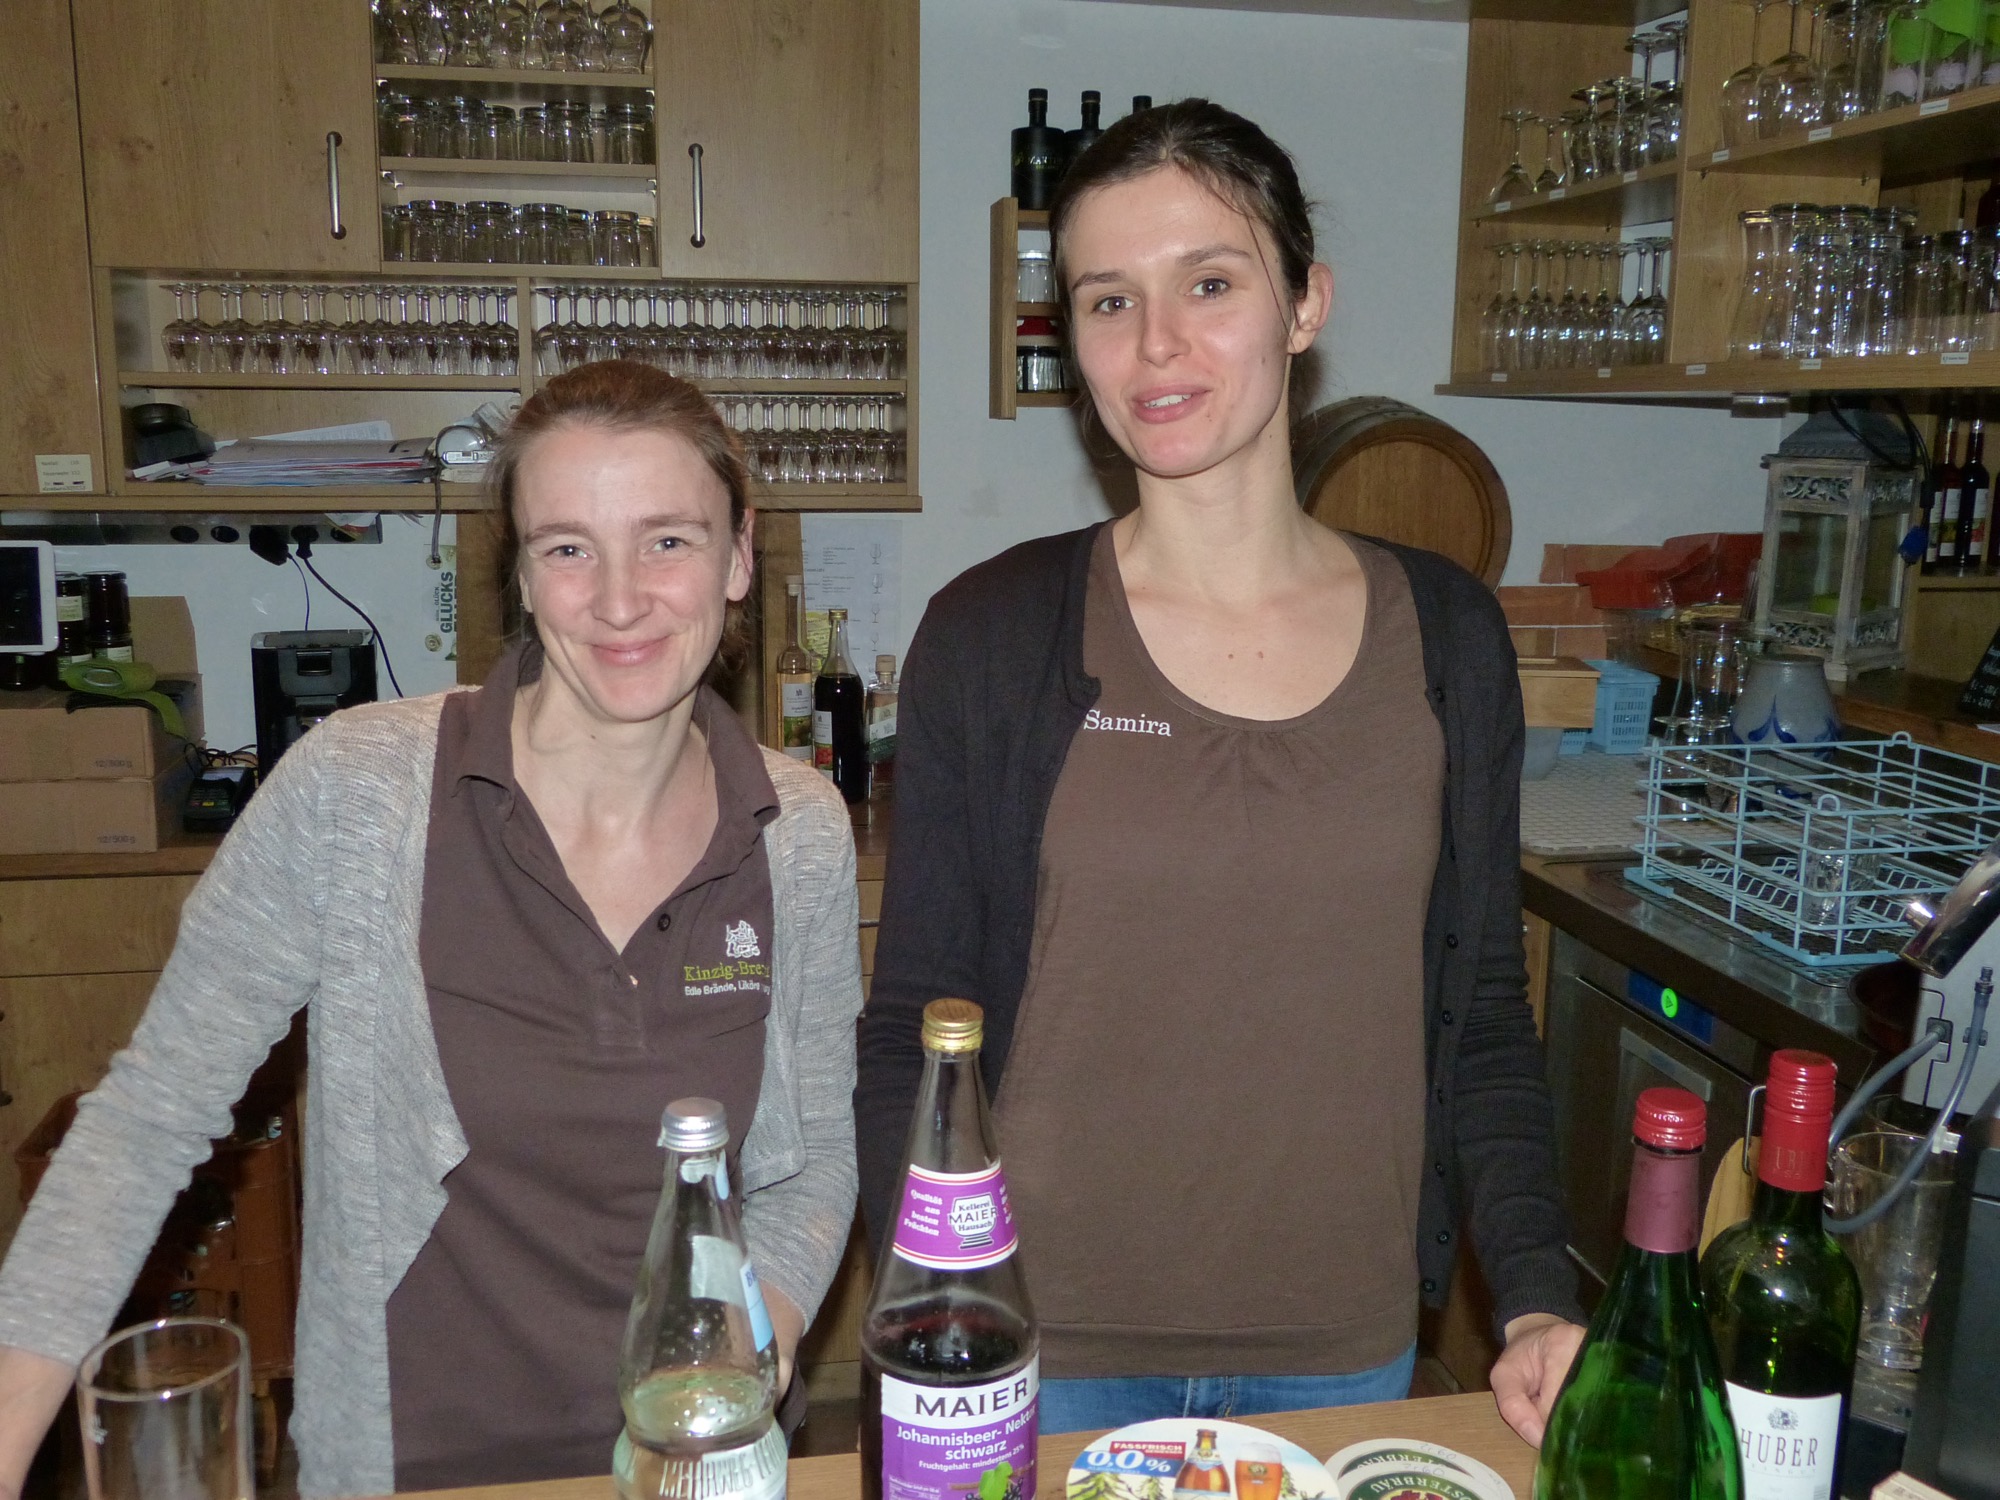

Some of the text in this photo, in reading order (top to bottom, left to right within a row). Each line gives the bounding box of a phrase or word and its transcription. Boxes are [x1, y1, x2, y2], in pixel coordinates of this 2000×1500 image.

[1083, 709, 1172, 737] Samira
[684, 986, 702, 996] Edle
[949, 1206, 998, 1225] MAIER
[958, 1200, 990, 1212] Kellerei
[958, 1220, 993, 1231] Hausach
[916, 1378, 1027, 1417] MAIER
[896, 1425, 1002, 1447] Johannisbeer-
[945, 1440, 1007, 1461] schwarz
[1741, 1428, 1819, 1467] HUBER
[918, 1460, 971, 1472] Fruchtgehalt:
[972, 1452, 1013, 1468] mindestens
[1087, 1450, 1144, 1469] 0,0
